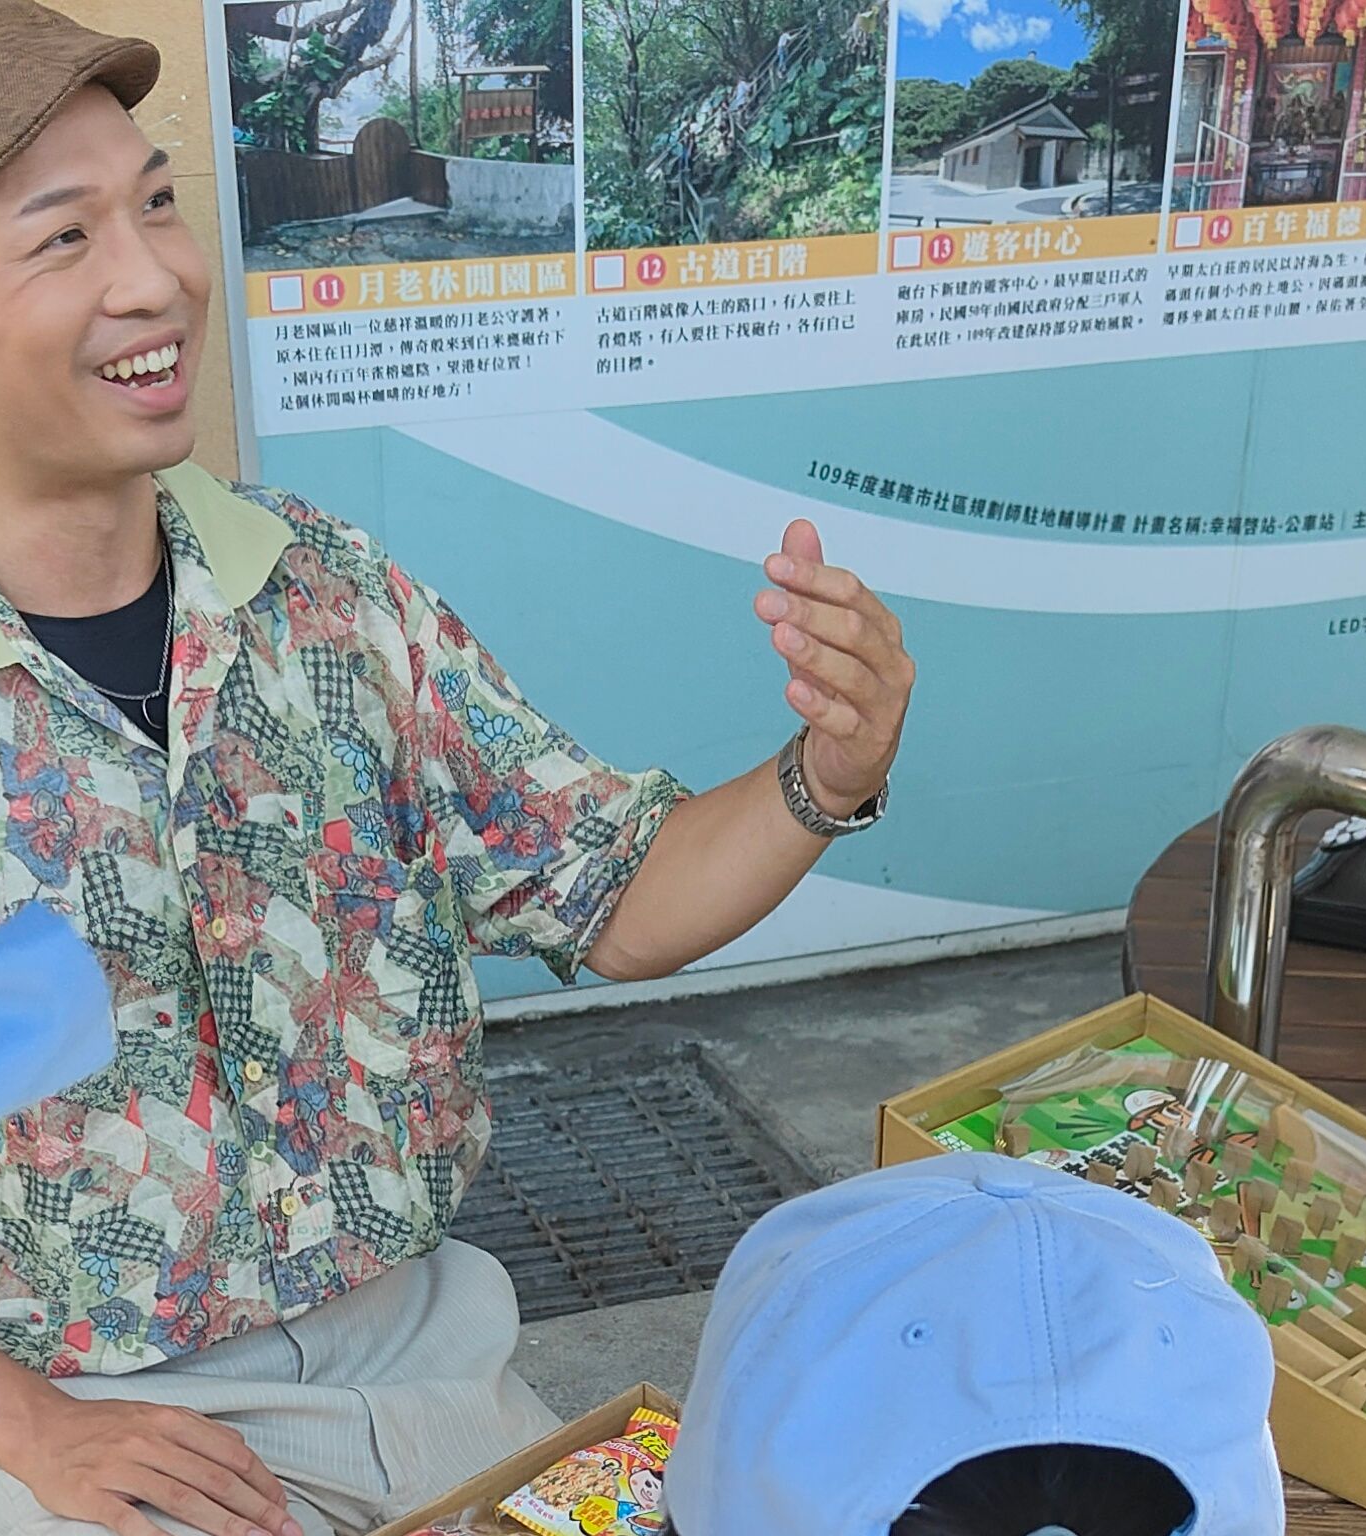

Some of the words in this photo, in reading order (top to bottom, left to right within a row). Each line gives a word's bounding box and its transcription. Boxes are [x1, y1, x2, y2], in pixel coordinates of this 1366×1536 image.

[931, 239, 951, 259] 13
[962, 224, 1082, 263] 遊客中心
[1212, 219, 1229, 239] 14
[318, 280, 341, 301] 11
[359, 259, 567, 305] 月老休閒園區
[641, 259, 662, 278] 12
[678, 243, 808, 283] 古道百階
